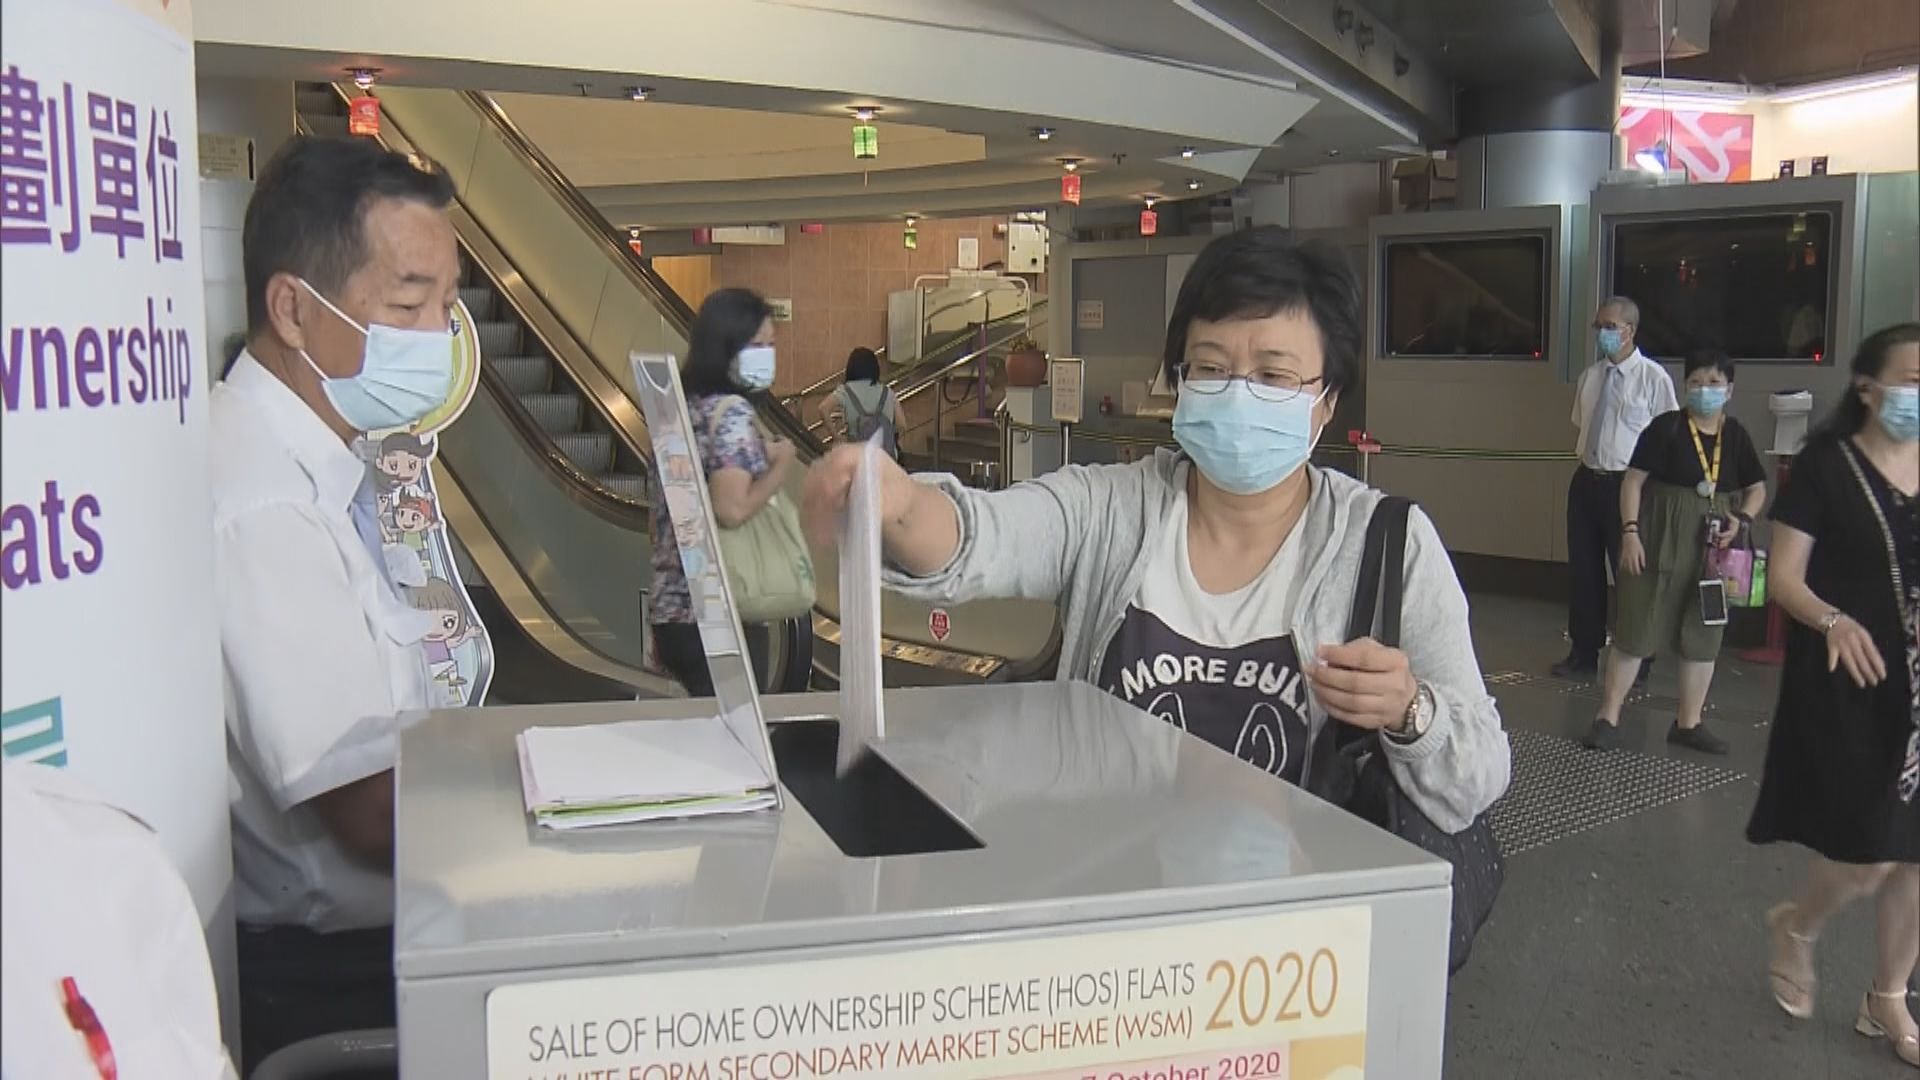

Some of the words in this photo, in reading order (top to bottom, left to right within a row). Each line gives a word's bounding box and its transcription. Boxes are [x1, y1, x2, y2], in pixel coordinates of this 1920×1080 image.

[2, 65, 183, 263] 劃單位
[2, 480, 103, 590] ats
[1120, 653, 1228, 701] MORE
[528, 1022, 598, 1062] SALE
[605, 1017, 647, 1054] OF
[656, 1007, 745, 1049] HOME
[752, 991, 926, 1040] OWNERSHIP
[931, 979, 1041, 1024] SCHEME
[1047, 968, 1120, 1018] (HOS)
[1127, 962, 1195, 1001] FLATS
[1204, 946, 1339, 1032] 2020
[718, 1040, 891, 1080] SECONDARY
[896, 1028, 1001, 1068] MARKET
[1007, 1018, 1108, 1056] SCHEME
[1115, 1005, 1194, 1049] (WSM)
[1218, 1051, 1281, 1080] 2020
